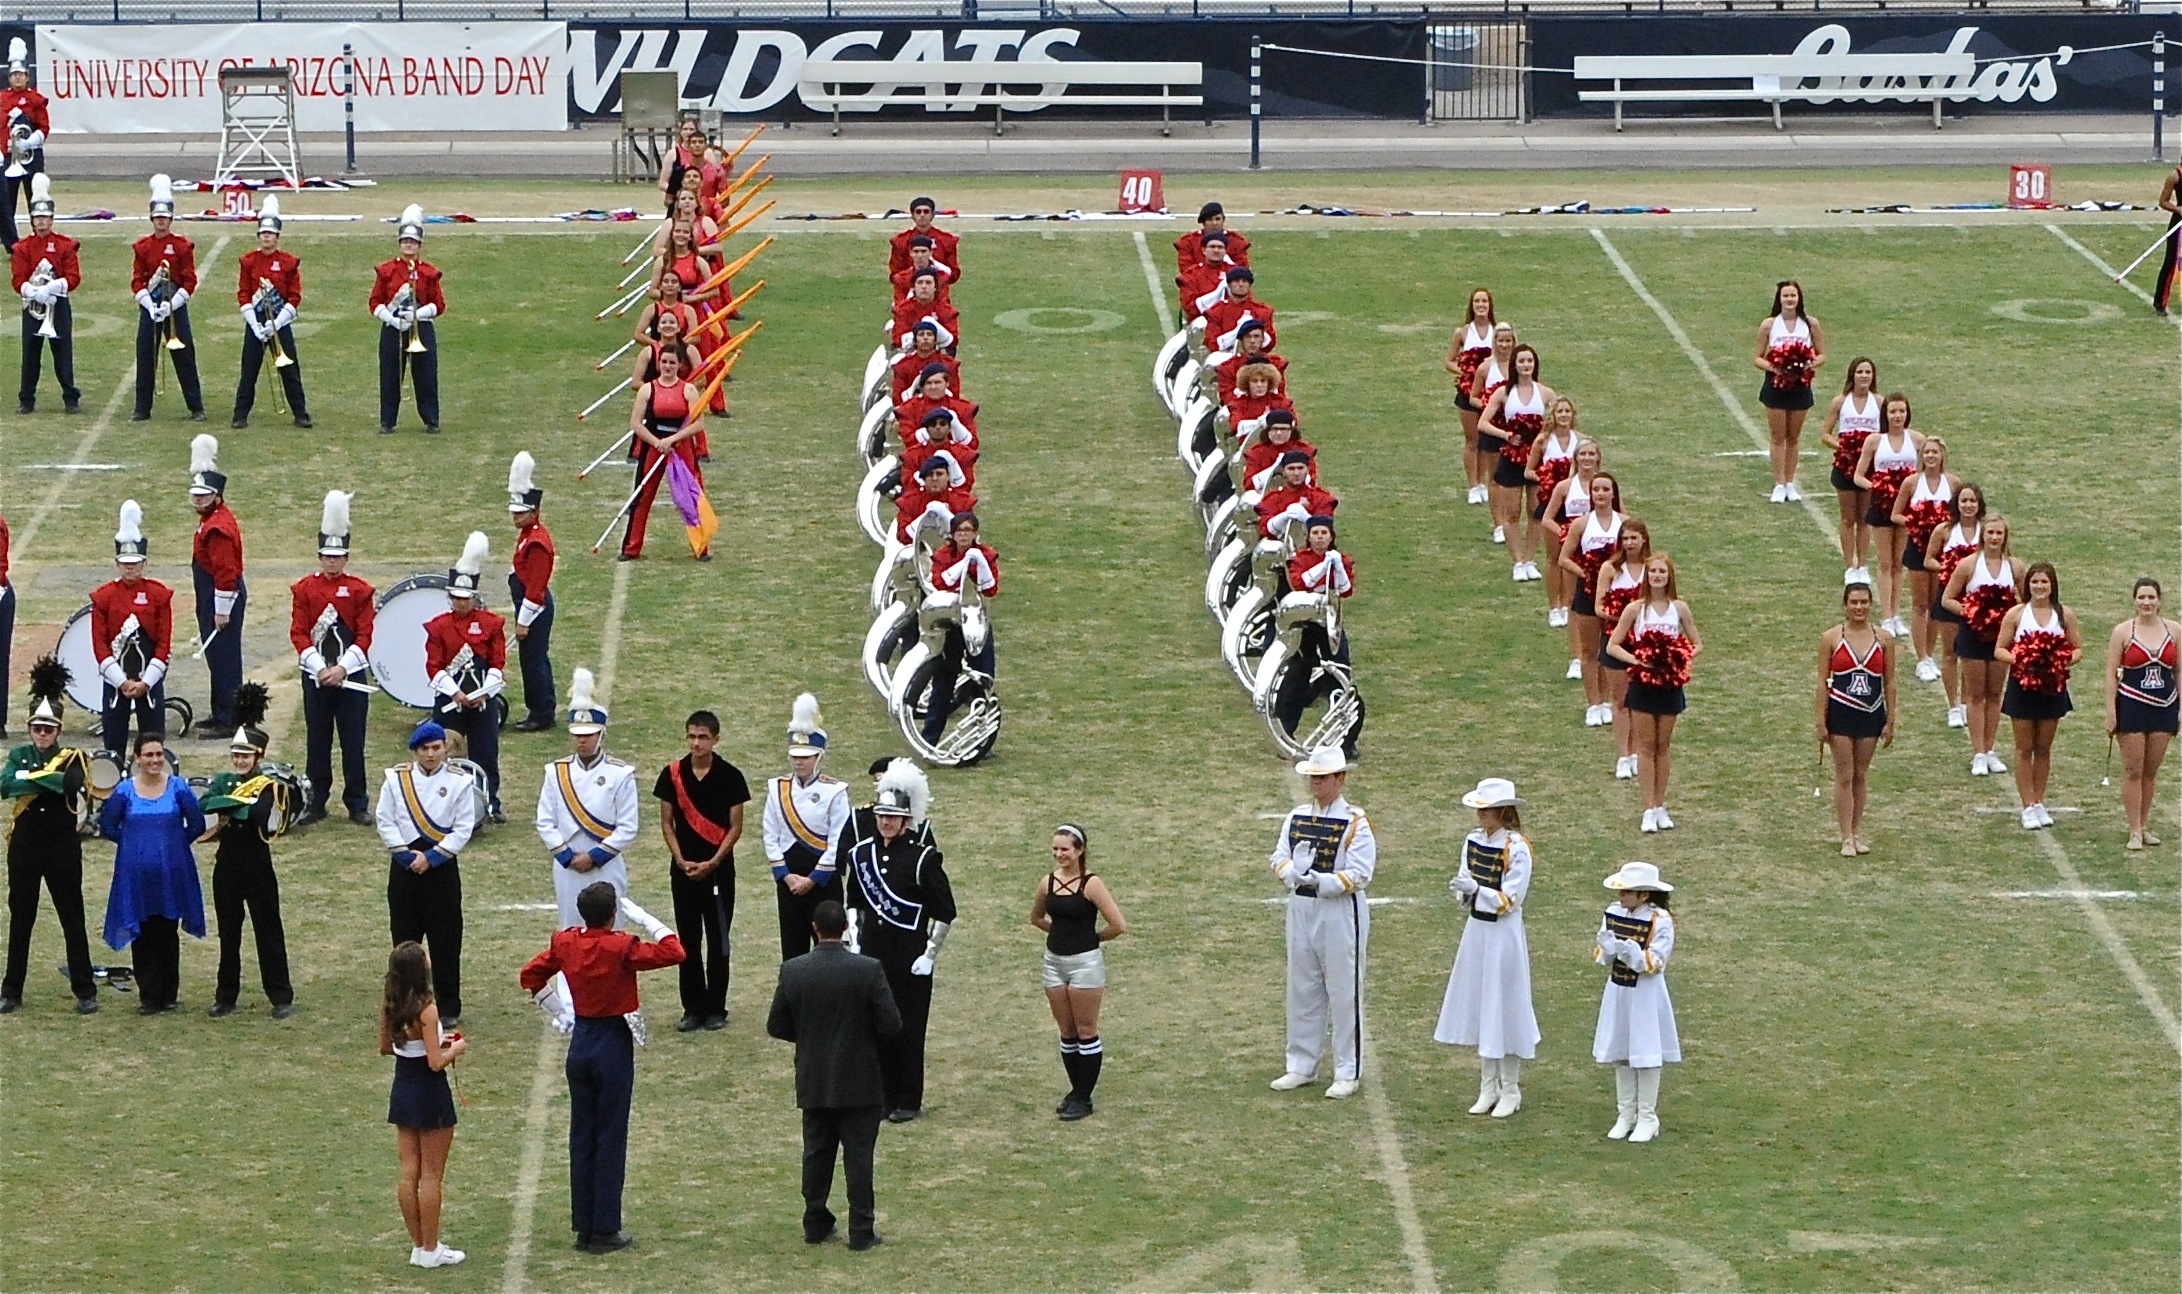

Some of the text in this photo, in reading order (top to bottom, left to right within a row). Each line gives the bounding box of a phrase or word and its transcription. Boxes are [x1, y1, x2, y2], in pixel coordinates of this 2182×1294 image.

[52, 58, 209, 99] UNIVERSITY
[403, 56, 485, 96] BAND
[494, 56, 550, 95] DAY
[567, 28, 1082, 113] WILDCATS
[1122, 175, 1154, 206] 40
[2015, 169, 2044, 201] 30
[224, 191, 251, 214] 50
[1846, 672, 1872, 696] A
[2140, 666, 2165, 690] A
